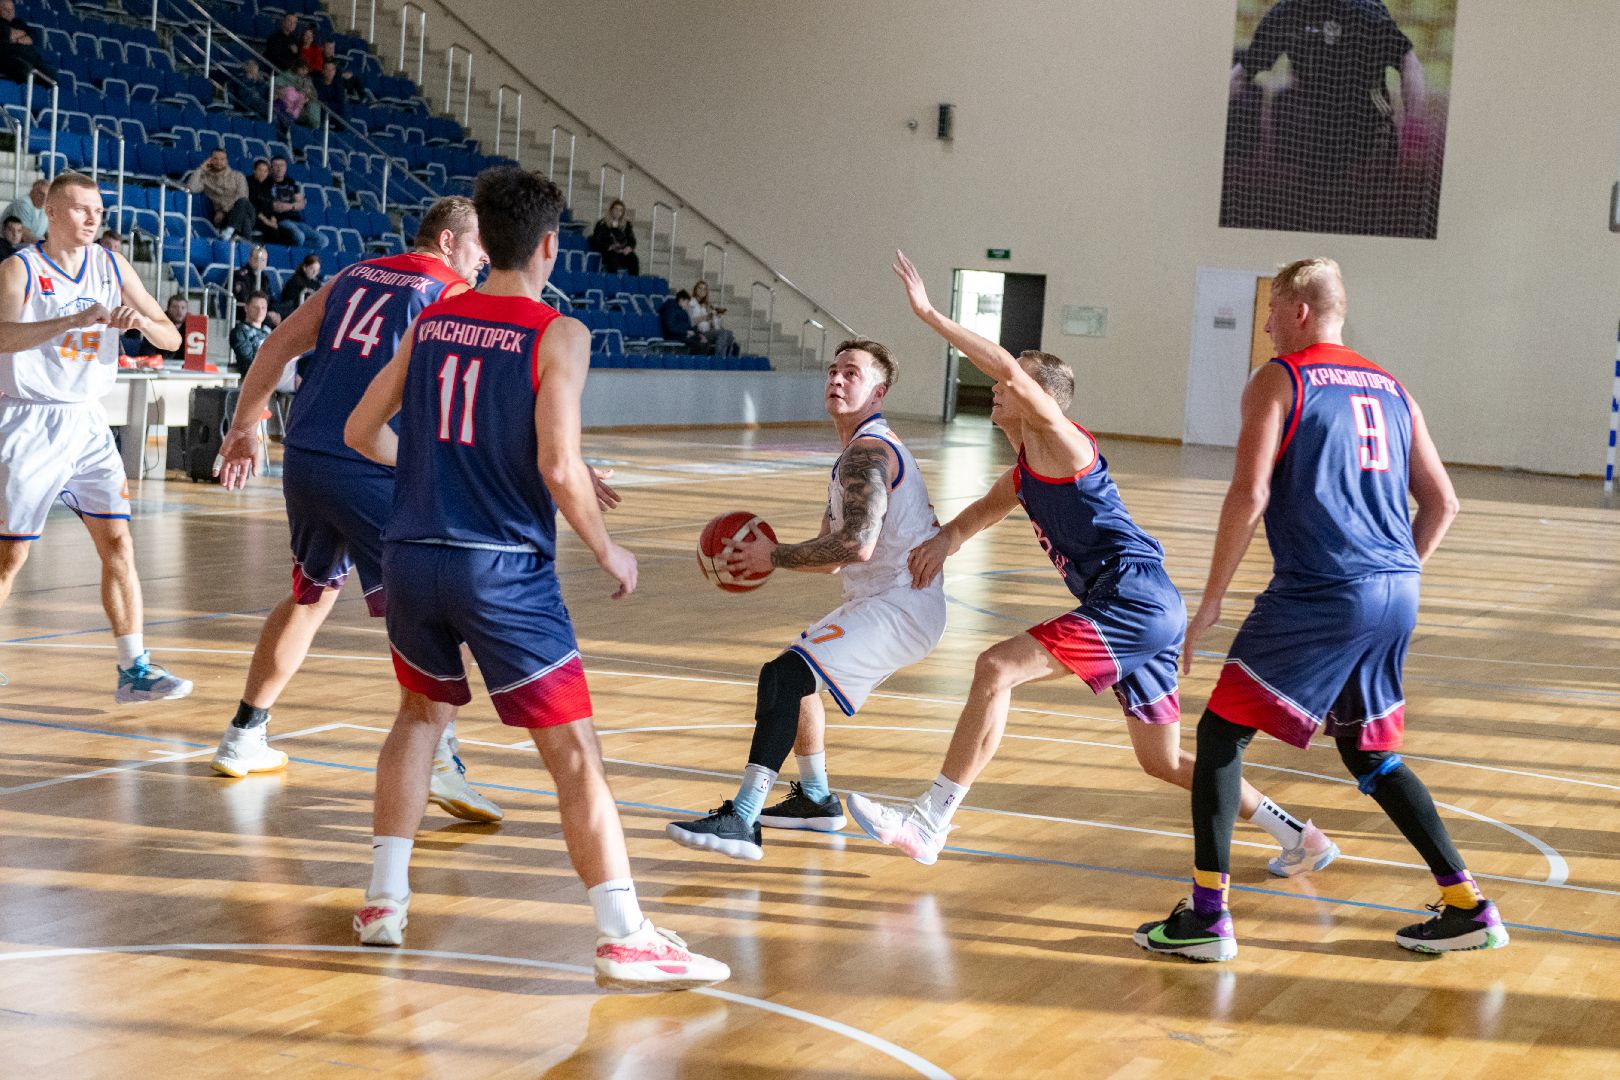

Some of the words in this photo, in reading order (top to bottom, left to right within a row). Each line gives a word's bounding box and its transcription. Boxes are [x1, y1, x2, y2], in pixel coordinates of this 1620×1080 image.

[348, 266, 435, 294] КРАСНОГОРСК
[331, 286, 393, 358] 14
[418, 320, 527, 353] КРАСНОГОРСК
[60, 331, 101, 362] 45
[1306, 367, 1400, 397] КРАСНОГОРСК
[438, 353, 483, 446] 11
[1349, 393, 1391, 473] 9
